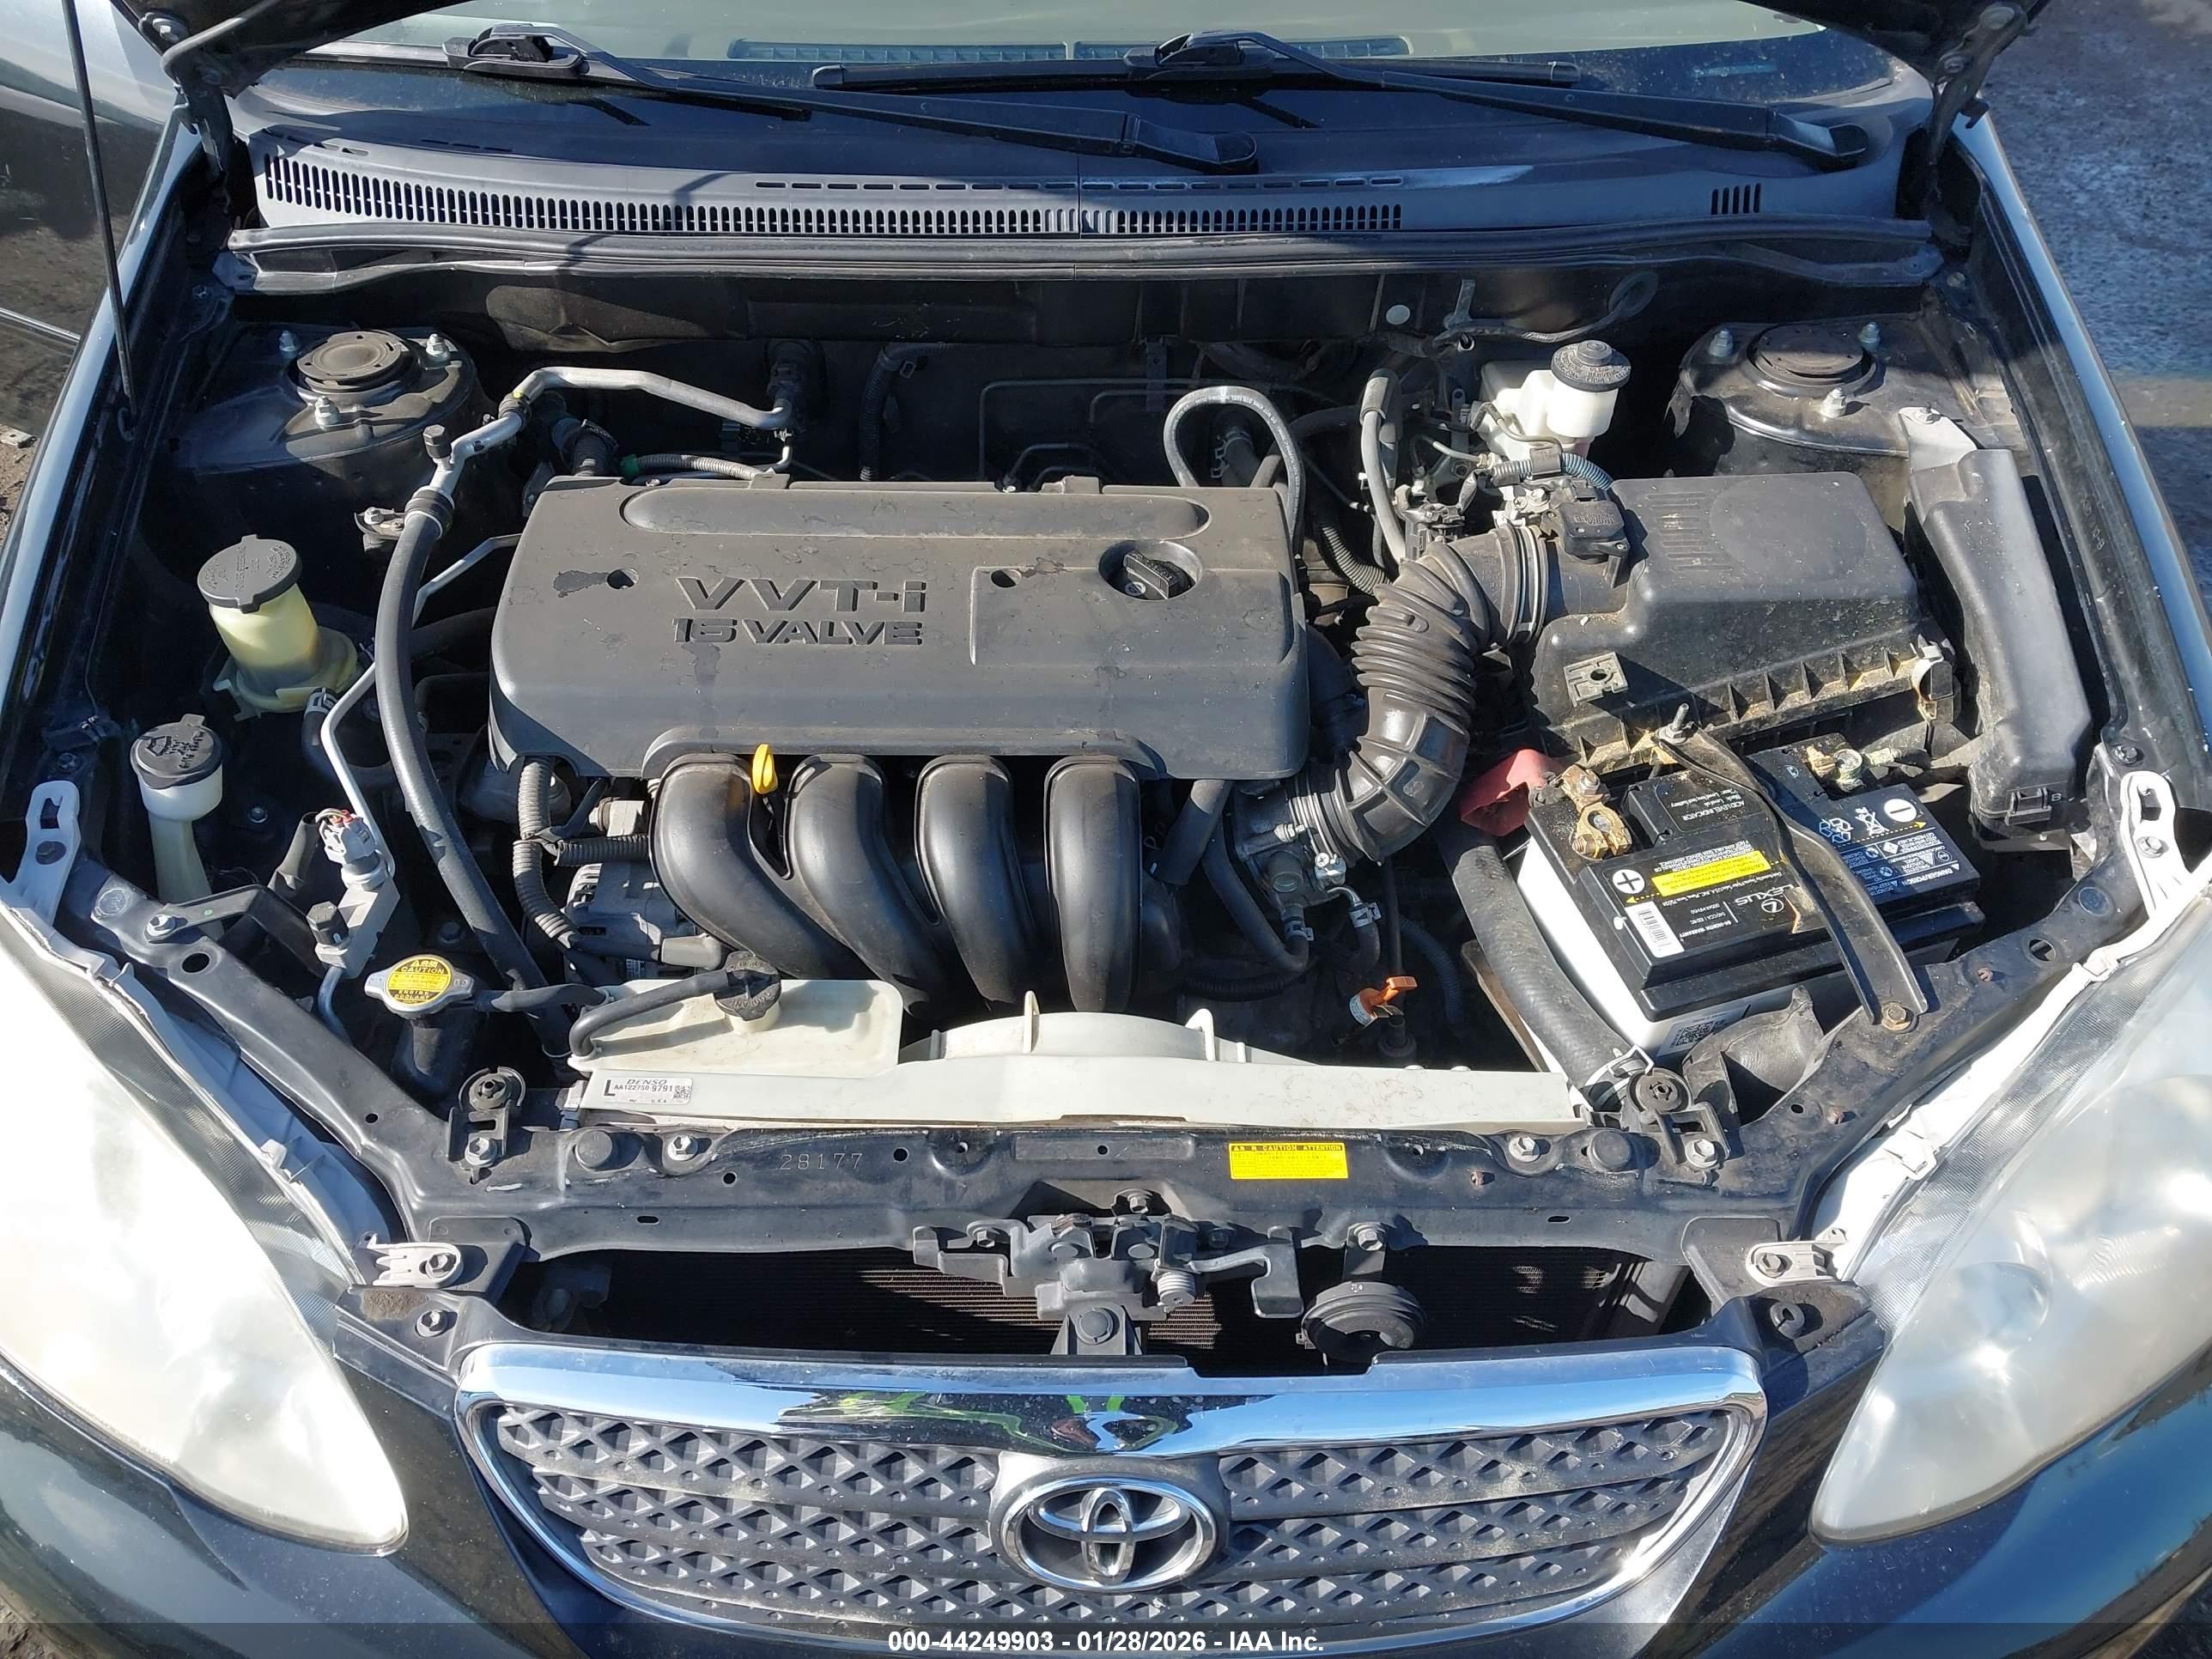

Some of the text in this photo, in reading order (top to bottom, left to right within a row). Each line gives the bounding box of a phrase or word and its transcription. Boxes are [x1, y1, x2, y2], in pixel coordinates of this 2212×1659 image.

[676, 578, 927, 612] VVT-i
[742, 617, 923, 646] VALVE
[1900, 867, 1954, 886] DANGER/POISON
[1733, 884, 1796, 905] LEXUS
[604, 1079, 616, 1097] L
[778, 1152, 864, 1171] 28177
